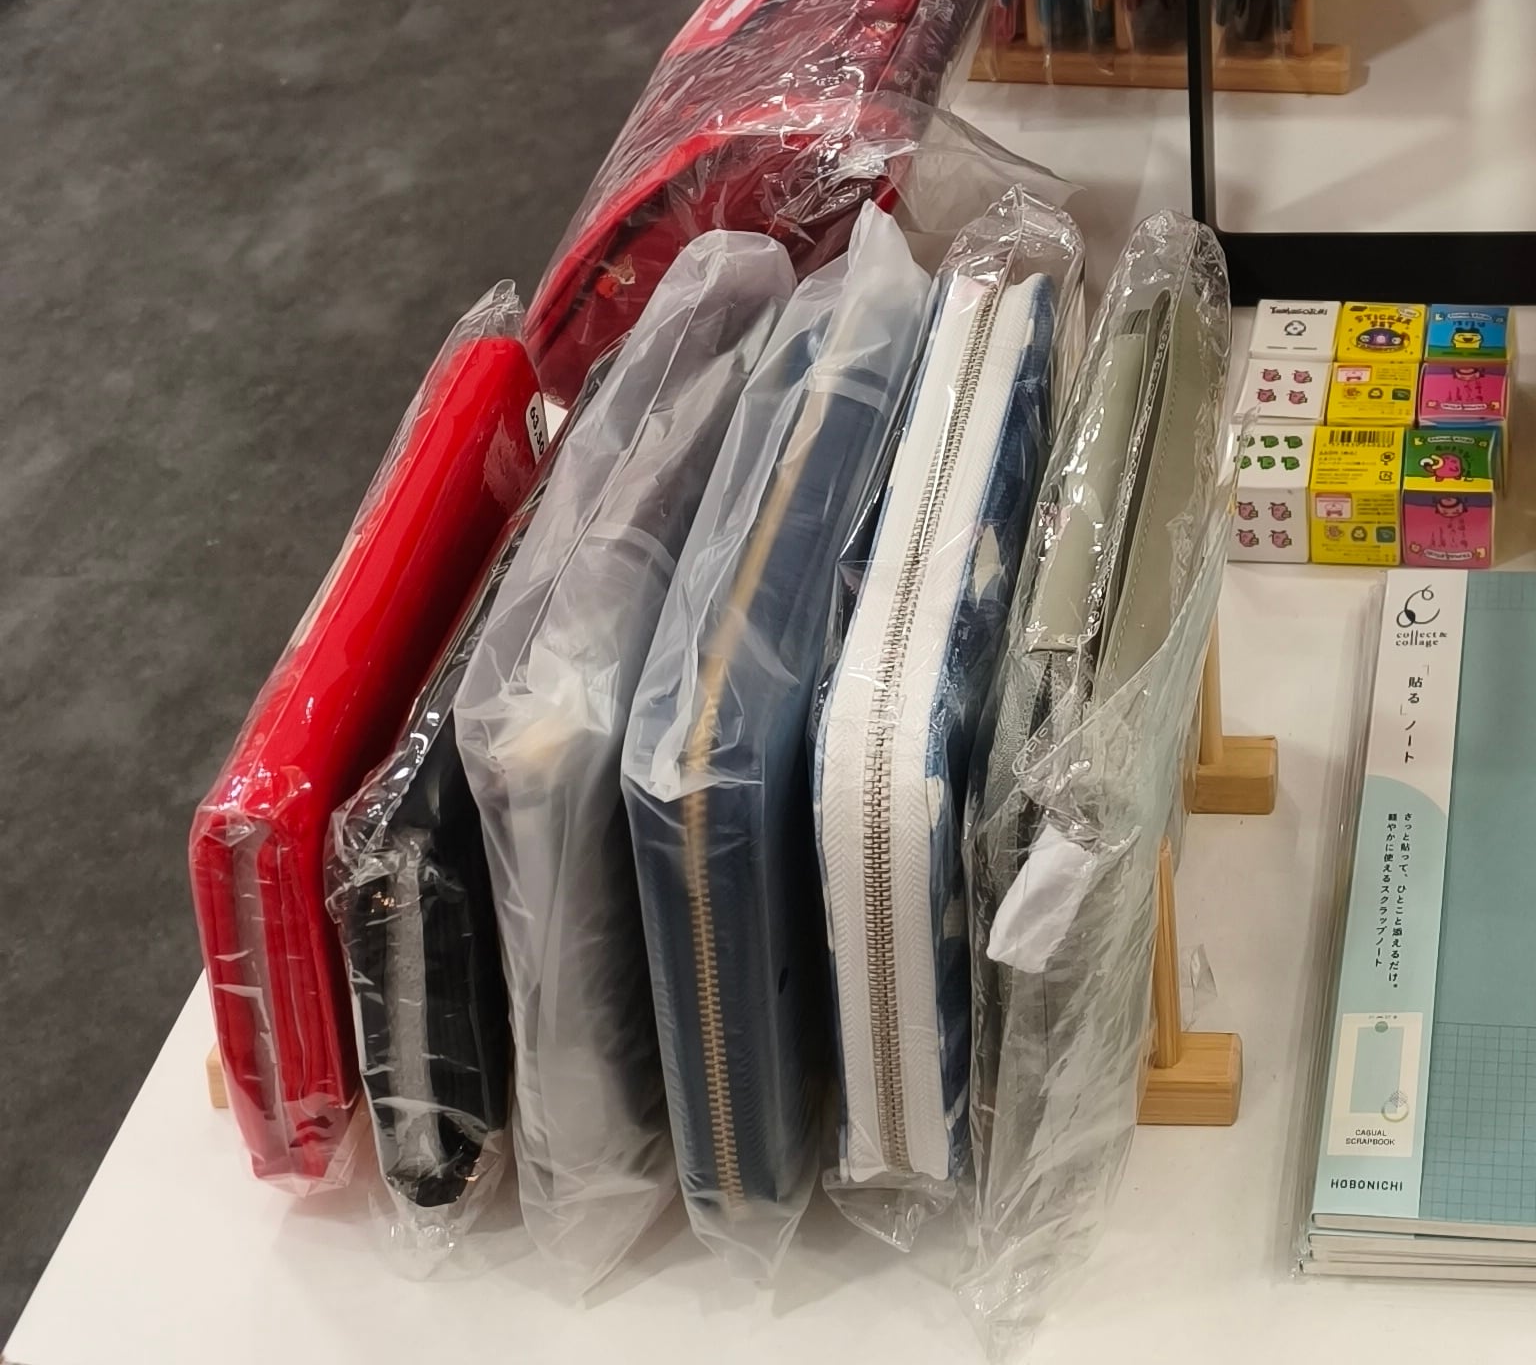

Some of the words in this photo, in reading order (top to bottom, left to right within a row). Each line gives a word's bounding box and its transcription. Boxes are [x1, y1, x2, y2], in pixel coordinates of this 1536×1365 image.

[1396, 638, 1439, 647] collage
[1355, 1129, 1387, 1137] CASUAL
[1346, 1138, 1395, 1146] SCRAPBOOK
[1331, 1179, 1403, 1191] HOBONICHI
